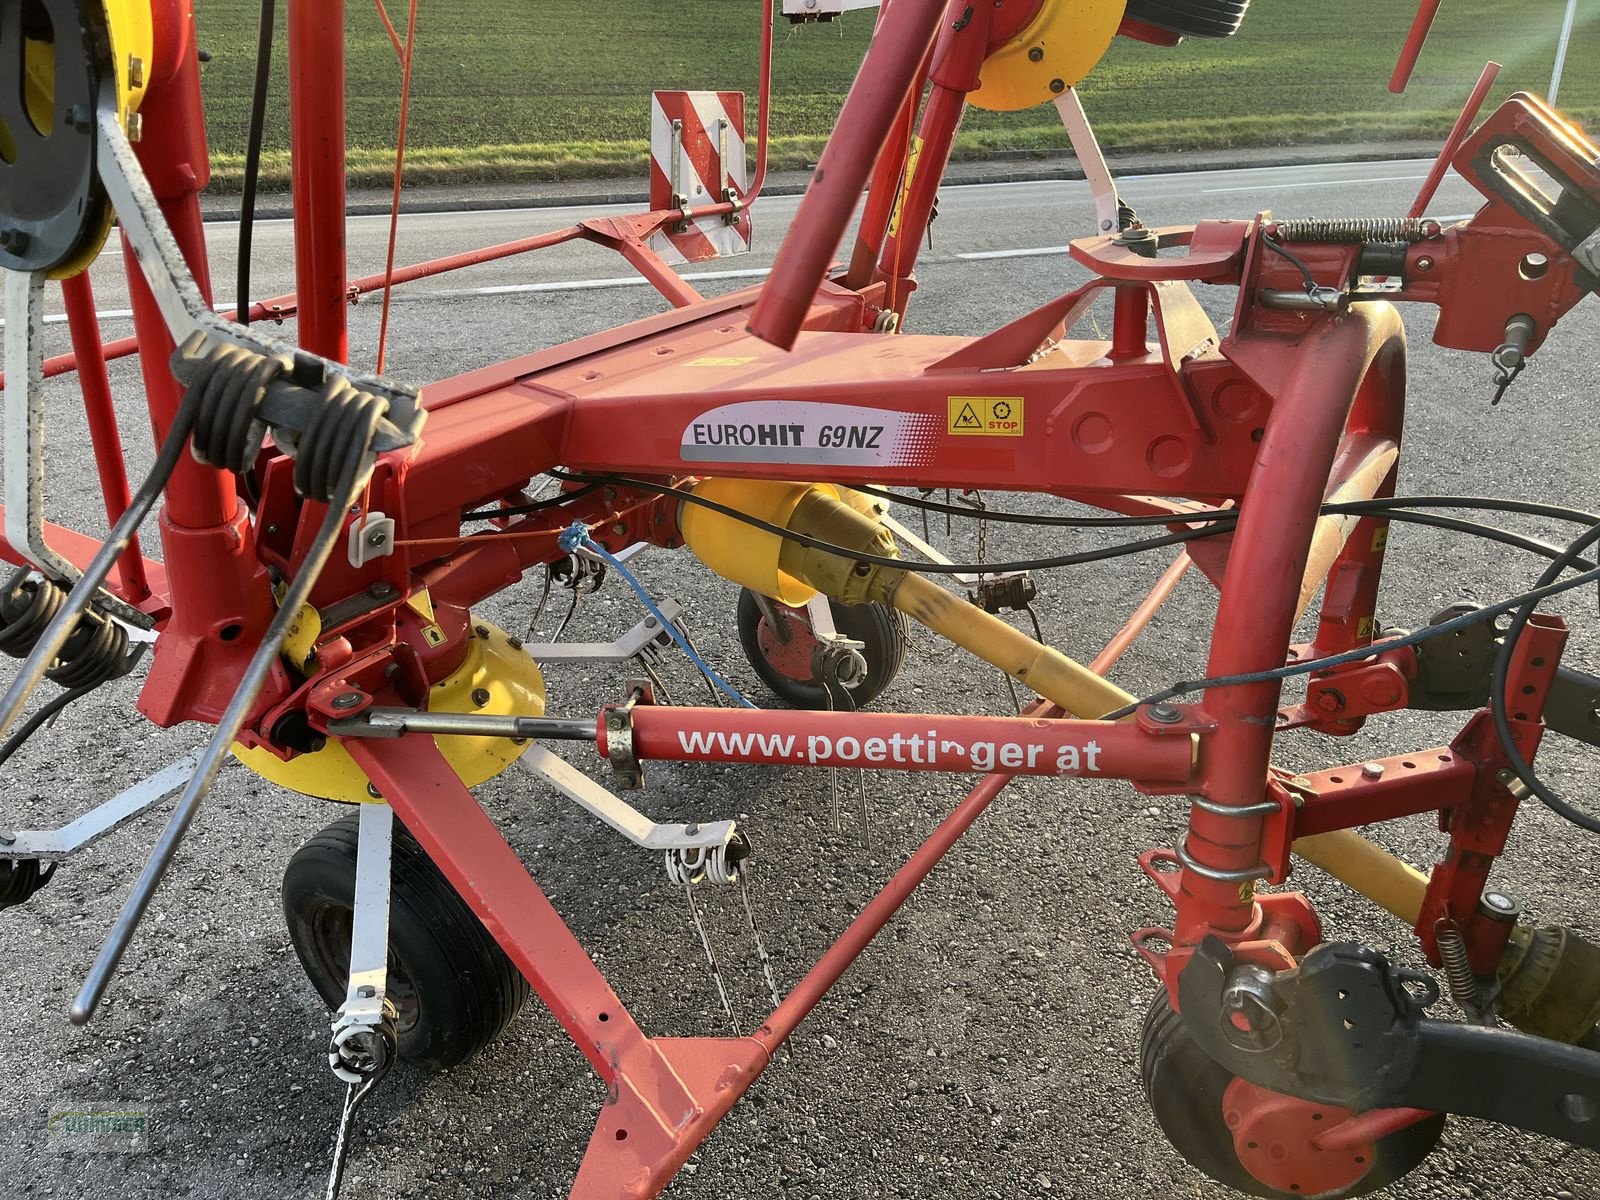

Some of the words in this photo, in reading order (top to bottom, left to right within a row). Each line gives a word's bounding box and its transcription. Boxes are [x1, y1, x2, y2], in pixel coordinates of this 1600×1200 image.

[988, 421, 1018, 429] STOP
[693, 423, 805, 447] EUROHIT
[818, 425, 884, 449] 69NZ
